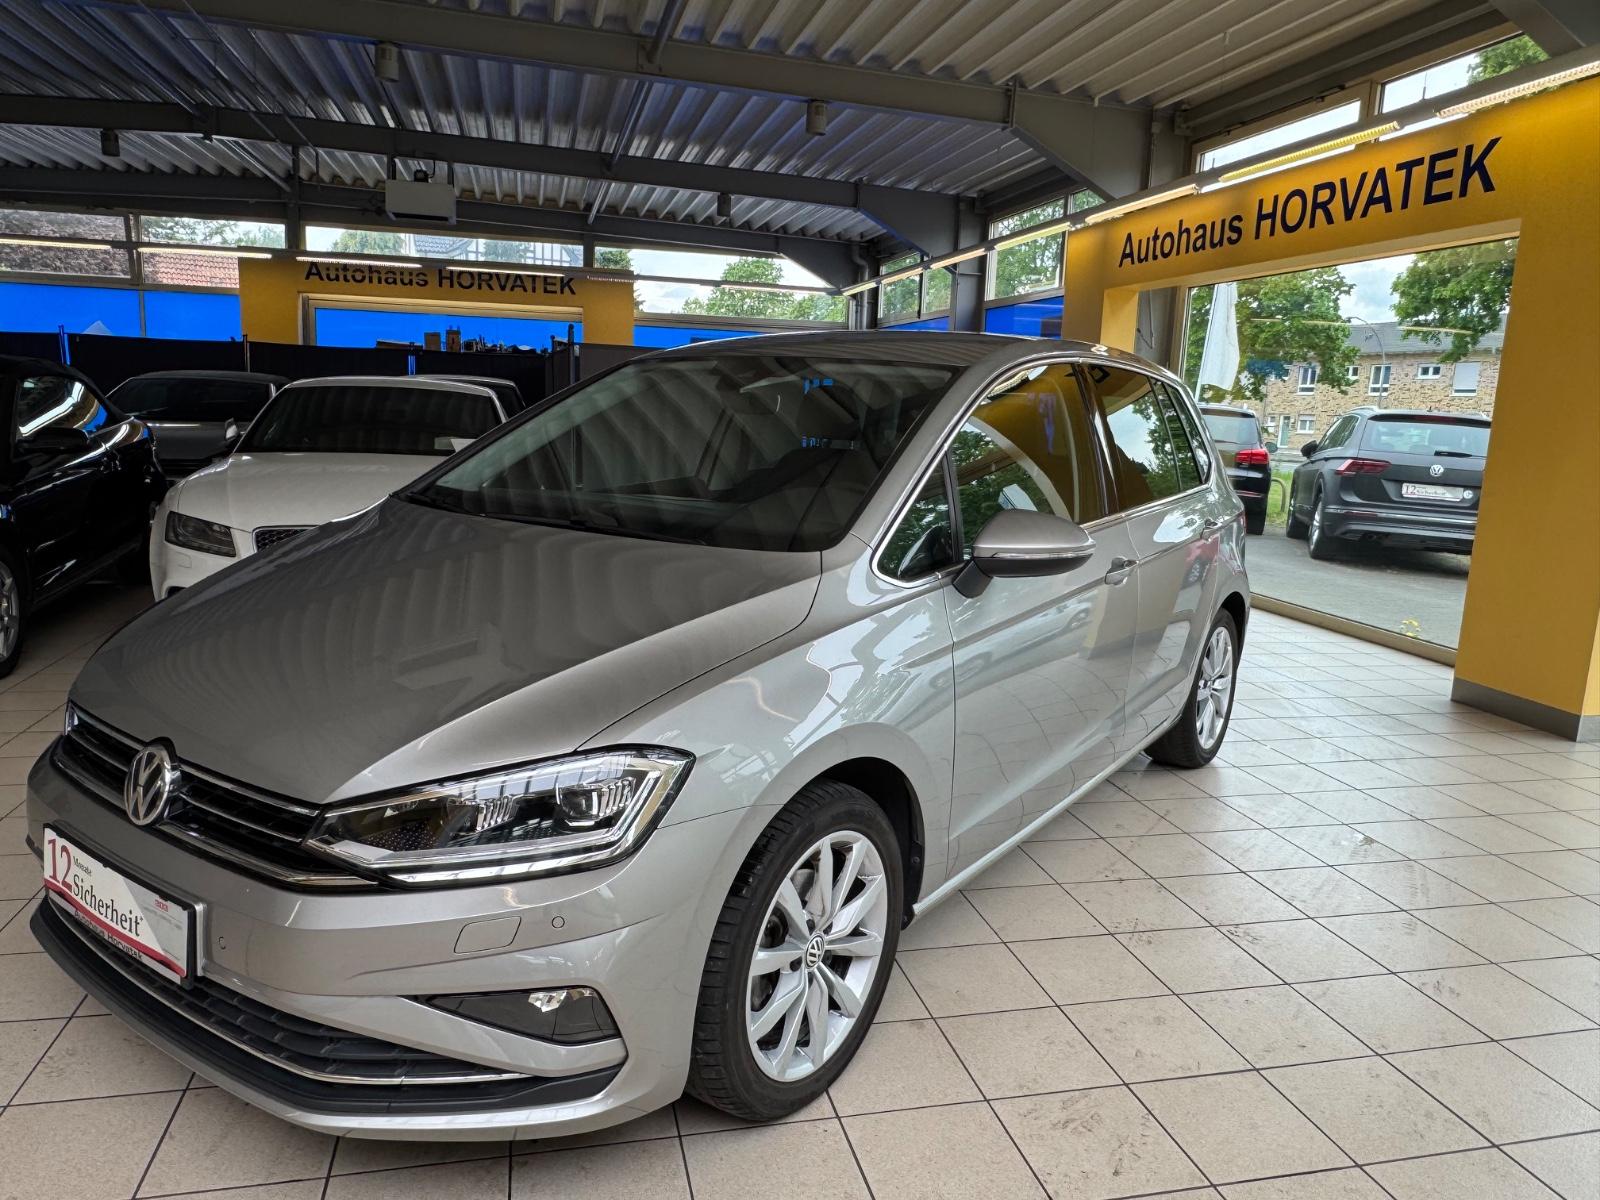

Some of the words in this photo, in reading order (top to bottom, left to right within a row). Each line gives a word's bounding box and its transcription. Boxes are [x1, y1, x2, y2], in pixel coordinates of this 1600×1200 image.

[1118, 213, 1243, 268] Autohaus
[1254, 136, 1502, 240] HORVATEK
[304, 261, 429, 288] Autohaus
[438, 268, 577, 296] HORVATEK
[48, 838, 73, 893] 12
